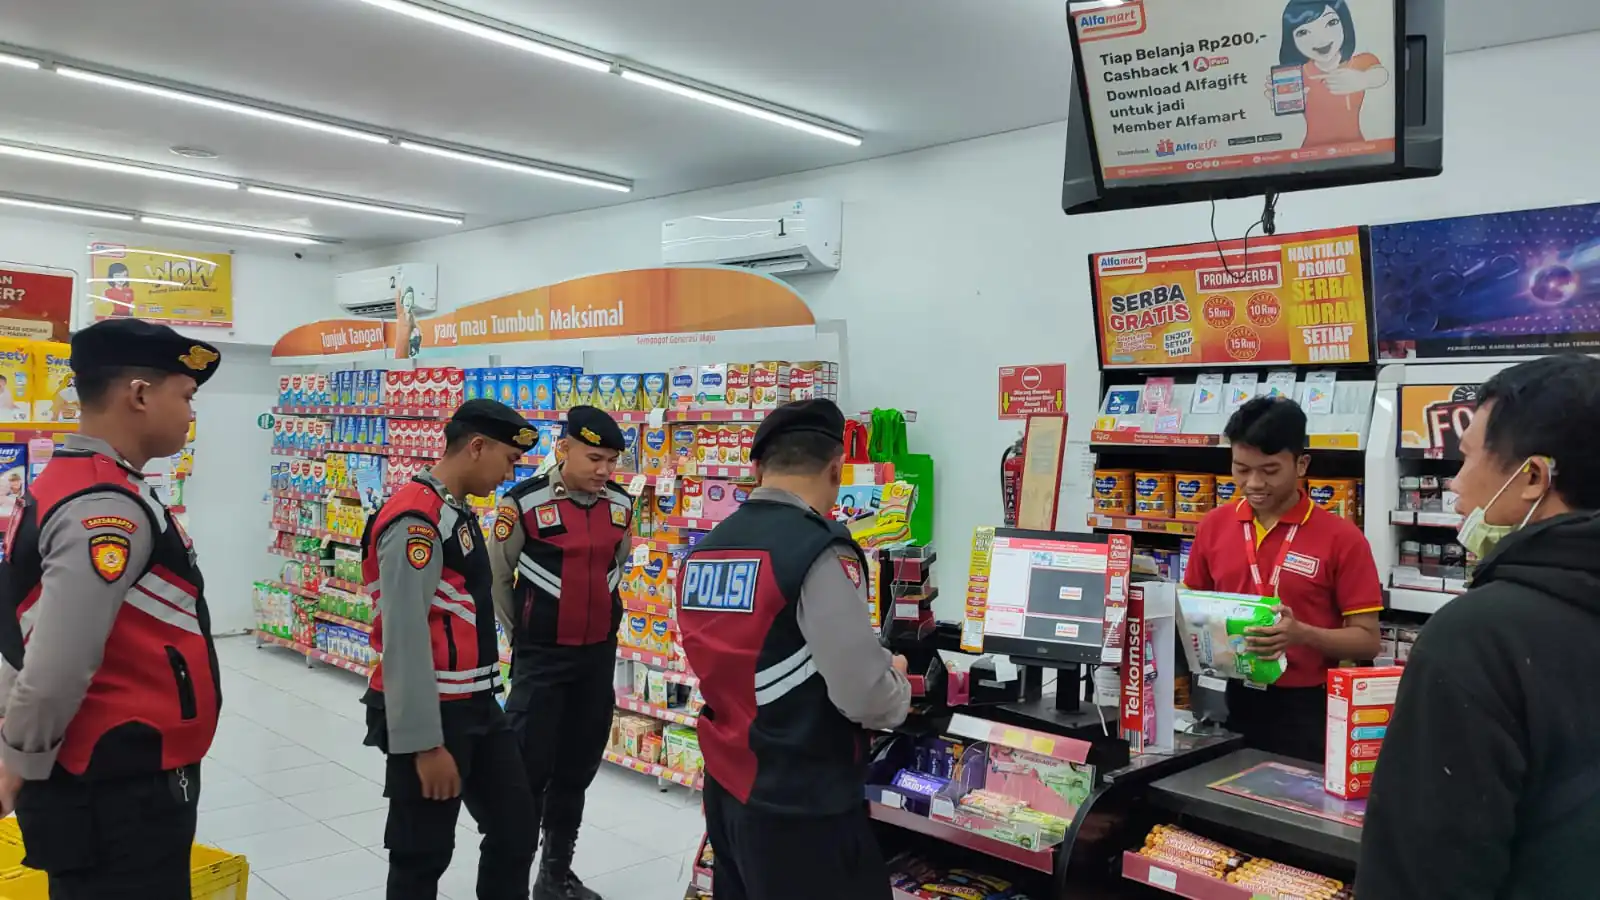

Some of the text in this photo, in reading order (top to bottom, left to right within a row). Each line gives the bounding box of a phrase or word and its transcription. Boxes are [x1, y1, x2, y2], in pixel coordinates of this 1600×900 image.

[1080, 10, 1136, 27] Alfamart
[1100, 32, 1267, 66] Tiap Belanja Rp200,-
[1103, 64, 1177, 83] Cashback
[1182, 61, 1191, 73] 1
[1107, 73, 1248, 102] Download Alfagift
[1110, 100, 1186, 118] untuk jadi
[1113, 109, 1246, 135] Member Alfamart
[1175, 139, 1218, 153] Alfagift
[777, 218, 787, 237] 1
[1100, 255, 1143, 267] Alfamart
[1288, 241, 1354, 263] NANTIKAN
[1297, 258, 1346, 277] PROMO
[390, 276, 396, 289] 2
[1291, 276, 1358, 301] SERBA
[1111, 284, 1185, 313] SERBA
[1110, 302, 1190, 332] GRATIS
[1291, 301, 1359, 325] MURAH
[320, 331, 347, 350] Tunjuk
[434, 321, 457, 345] yang
[460, 319, 488, 336] mau
[490, 308, 544, 334] Tumbuh
[550, 299, 624, 330] Maksimal
[1165, 331, 1190, 341] ENJOY
[1165, 337, 1193, 349] SETIAP
[1303, 327, 1353, 345] SETIAP
[1170, 346, 1190, 356] HARI
[684, 563, 755, 608] POLISI
[1125, 617, 1141, 718] Telkomsel
[901, 779, 924, 792] DAIRY
